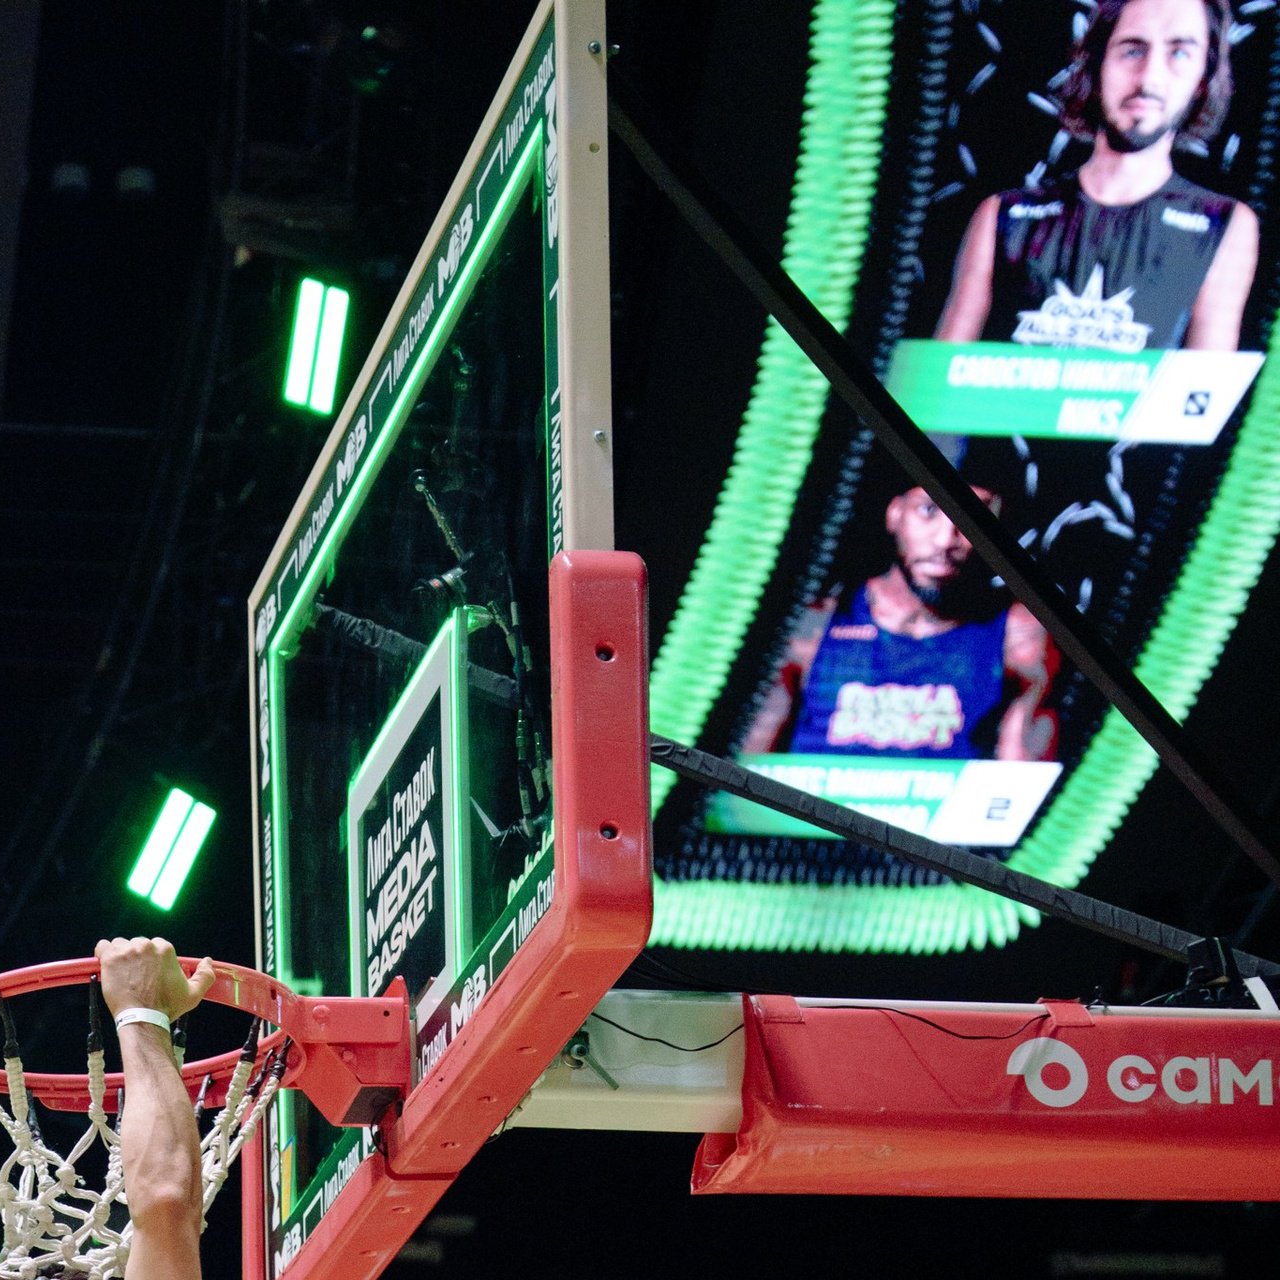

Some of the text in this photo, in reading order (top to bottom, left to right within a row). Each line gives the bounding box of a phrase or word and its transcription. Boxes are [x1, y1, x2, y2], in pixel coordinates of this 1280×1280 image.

[366, 746, 436, 898] ЛИГА СТАВОК
[366, 819, 437, 958] MEDIA
[367, 865, 437, 998] BASKET
[1107, 1053, 1280, 1106] сам
